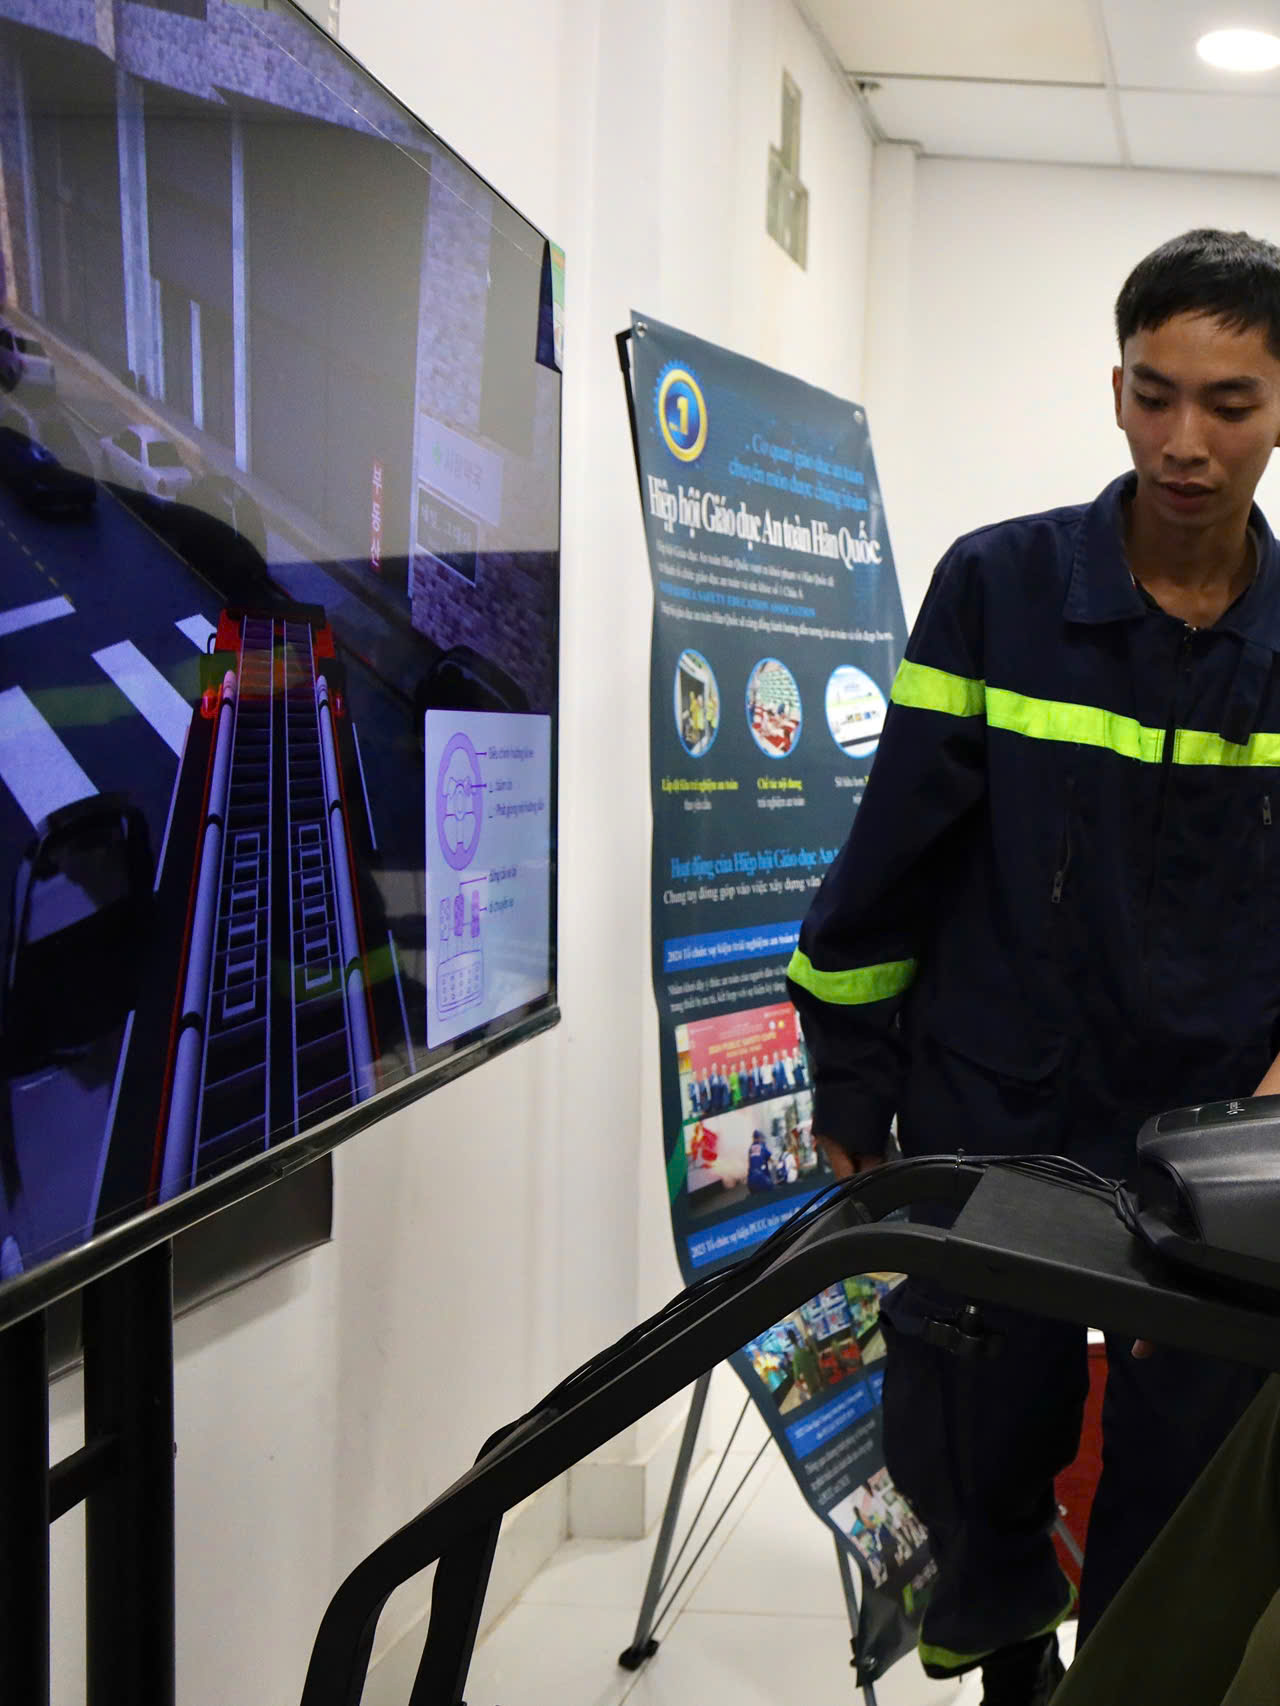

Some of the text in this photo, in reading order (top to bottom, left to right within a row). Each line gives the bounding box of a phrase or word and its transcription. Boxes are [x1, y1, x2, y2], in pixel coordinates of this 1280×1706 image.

[648, 474, 678, 534] Hiệp
[679, 484, 701, 538] hội
[702, 492, 736, 537] Giáo
[736, 502, 761, 550] dục
[762, 509, 783, 547] An
[783, 514, 811, 555] toàn
[811, 519, 839, 560] Hàn
[839, 520, 882, 570] Quốc
